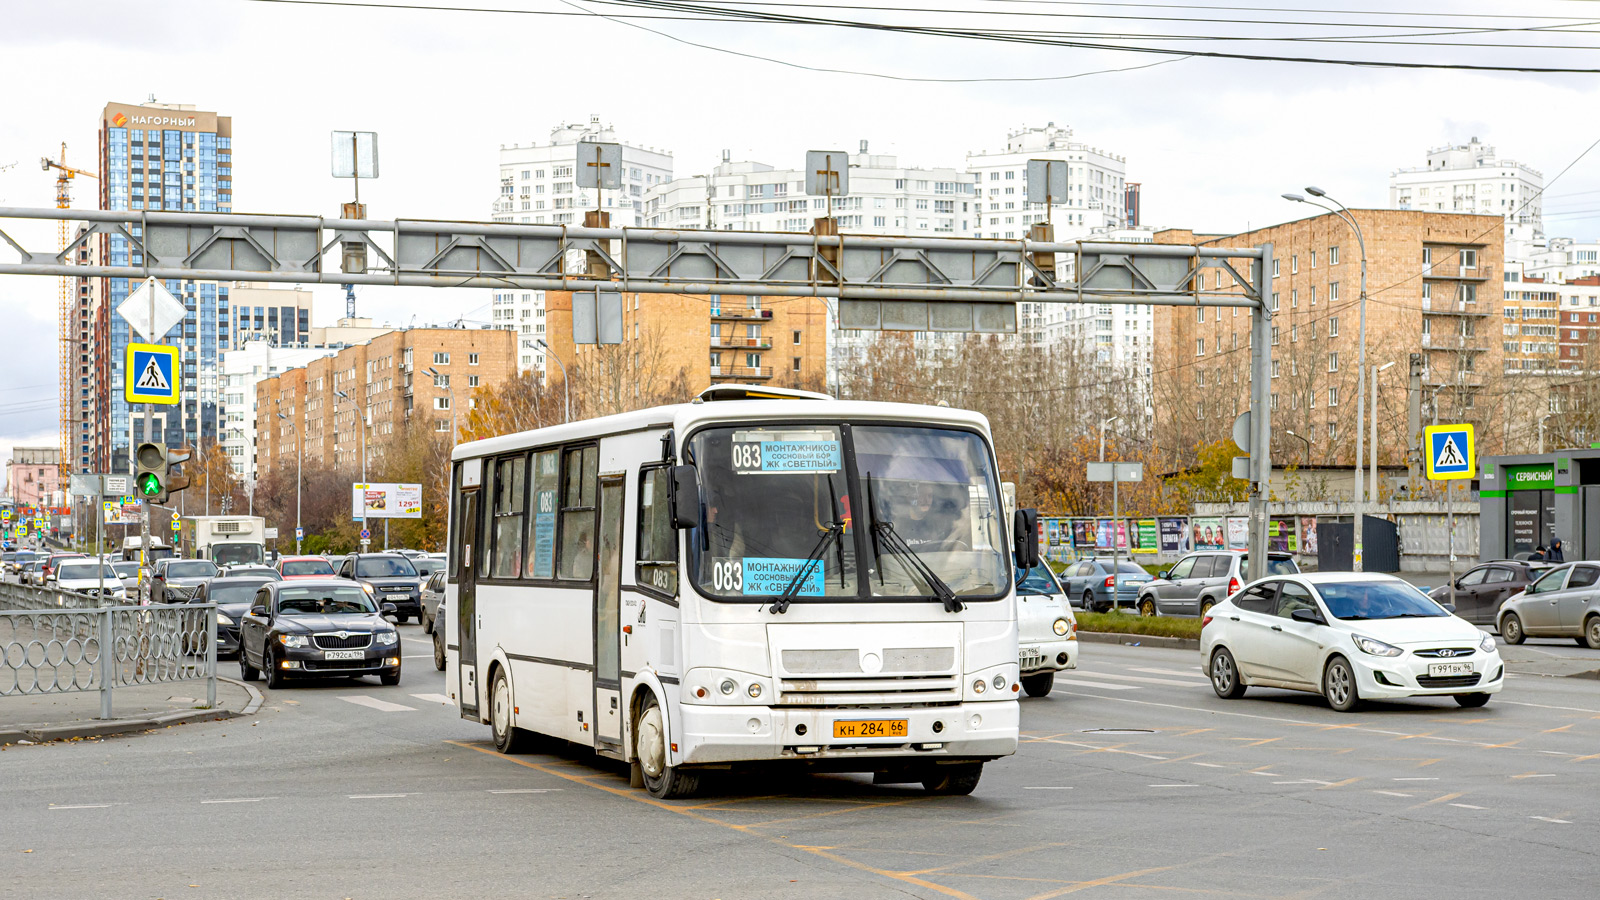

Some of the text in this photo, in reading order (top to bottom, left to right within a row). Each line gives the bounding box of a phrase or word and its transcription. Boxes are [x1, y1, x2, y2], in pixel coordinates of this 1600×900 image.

[131, 116, 196, 127] НАГОРНЫЙ
[765, 444, 837, 452] МОНТАЖНИКОВ
[732, 444, 761, 468] 083
[543, 454, 554, 474] 083
[782, 458, 838, 468] «СВЕТЛЫЙ»
[1516, 470, 1552, 482] СЕРВИСНЫЙ
[540, 492, 552, 513] 083
[747, 563, 820, 573] МОНТАЖНИКОВ
[653, 568, 668, 589] 083
[714, 562, 743, 591] 083
[748, 583, 761, 592] ЖК
[1432, 665, 1462, 673] Т991ВК
[840, 722, 903, 735] КН 284 66
